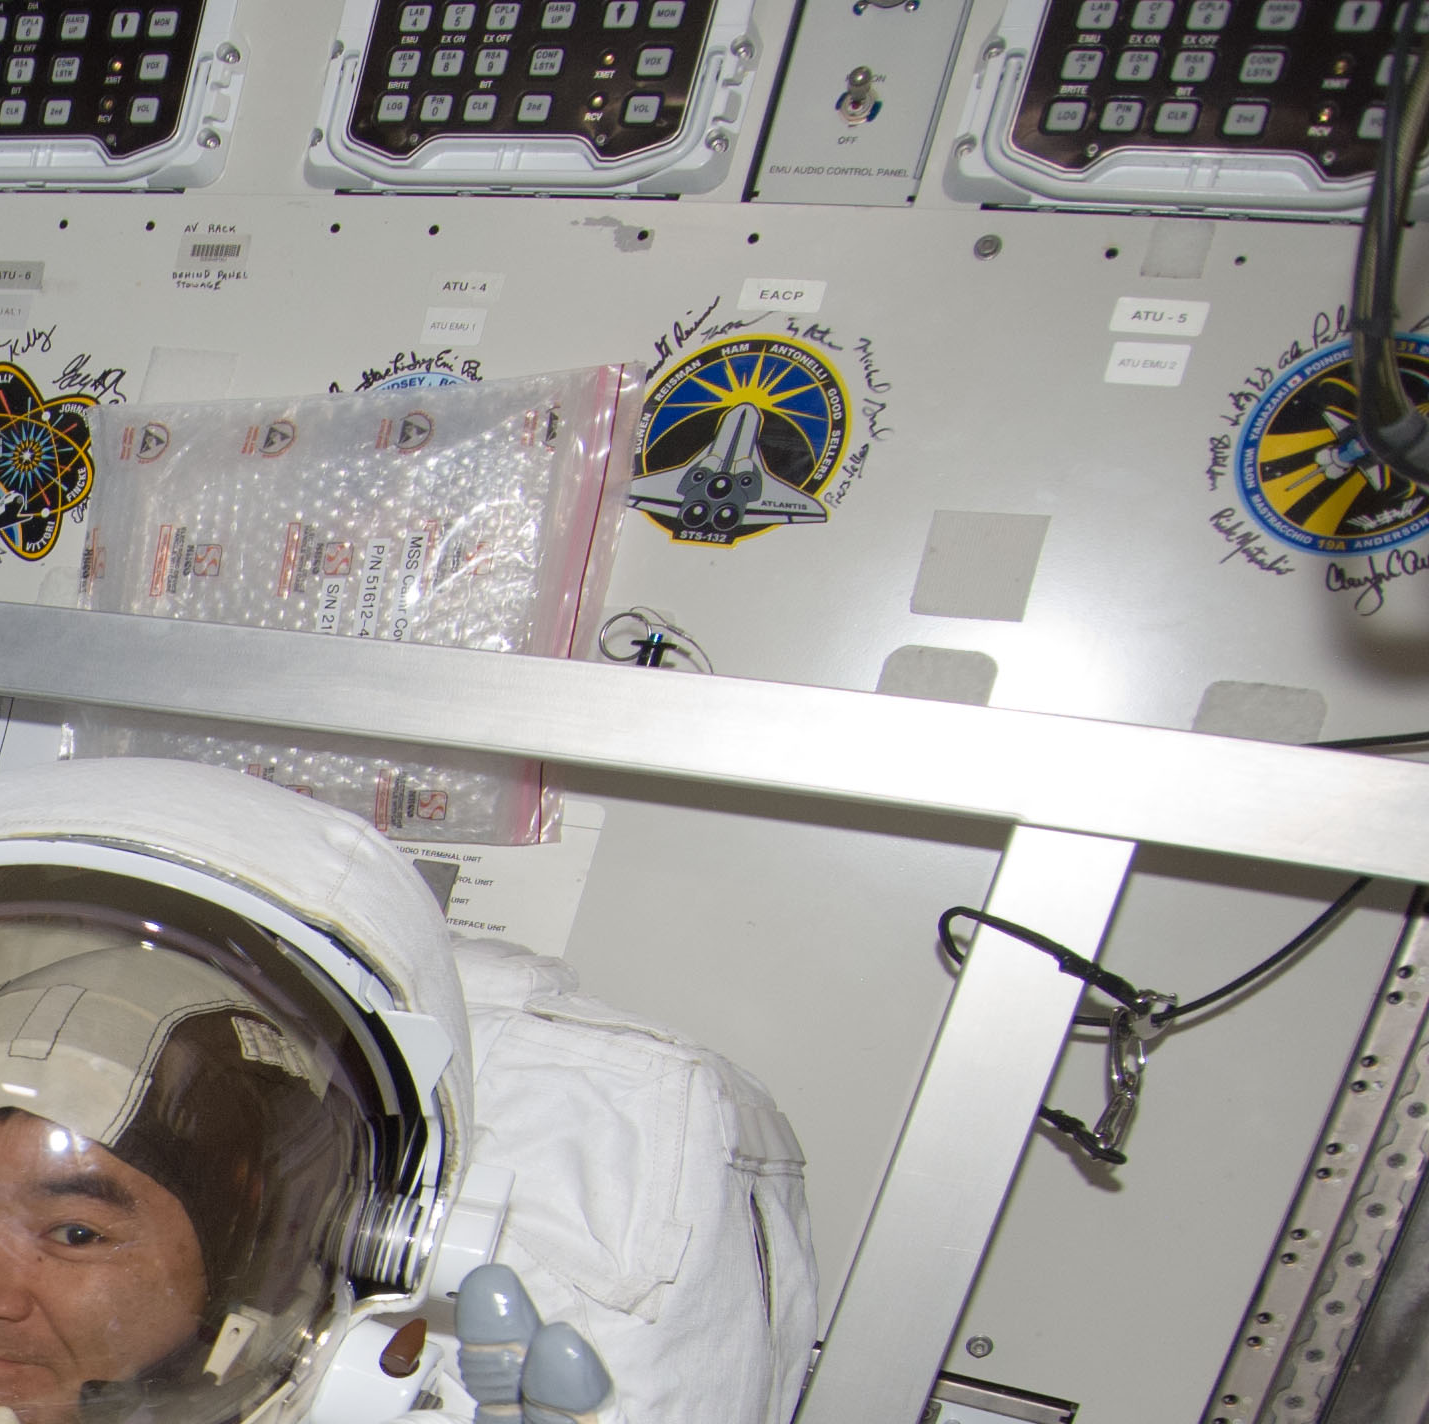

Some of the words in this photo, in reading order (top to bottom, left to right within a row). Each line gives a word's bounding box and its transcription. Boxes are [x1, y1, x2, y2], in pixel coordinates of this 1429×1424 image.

[408, 7, 425, 17] LAB
[455, 6, 466, 15] CF
[494, 5, 516, 15] CPLA
[547, 4, 571, 14] HANG
[1090, 2, 1111, 12] LAB
[656, 9, 677, 18] MON
[411, 17, 418, 27] 4
[454, 16, 461, 26] 5
[498, 15, 506, 26] 6
[550, 15, 563, 24] UP
[401, 35, 419, 44] EMU
[441, 35, 452, 44] EX
[453, 35, 466, 44] ON
[483, 35, 494, 43] EX
[495, 34, 513, 43] OFF
[397, 53, 415, 62] JEM
[441, 52, 457, 61] ESA
[485, 51, 502, 60] RSA
[535, 50, 559, 60] CONF
[644, 56, 663, 66] VOX
[401, 62, 408, 72] 7
[443, 62, 450, 72] 8
[487, 61, 494, 72] 9
[533, 61, 557, 72] LSTN
[594, 70, 615, 79] XMIT
[479, 80, 493, 89] BIT
[430, 96, 445, 106] PIN
[471, 101, 488, 111] CLR
[386, 102, 403, 111] LOG
[431, 106, 439, 117] 0
[526, 102, 542, 112] 2nd
[633, 104, 650, 114] VOL
[584, 112, 603, 121] RCV
[837, 136, 858, 144] OFF
[769, 166, 791, 174] EMU
[793, 166, 823, 175] AUDIO
[826, 167, 874, 176] CONTROL
[876, 168, 909, 177] PANEL
[184, 222, 198, 233] AV
[208, 224, 236, 233] RACK
[24, 271, 32, 280] 6
[173, 271, 210, 279] BEHIND
[218, 271, 248, 279] PANEL
[176, 281, 221, 290] STOWAGE
[443, 282, 468, 291] ATU
[479, 283, 487, 291] 4
[759, 290, 805, 301] EACP
[1131, 310, 1164, 321] ATU
[1177, 313, 1188, 323] 5
[430, 322, 447, 330] ATU
[721, 343, 750, 356] HAM
[769, 344, 828, 380] ANTONELLI
[1118, 359, 1140, 368] ATU
[1141, 360, 1167, 368] EMU
[1169, 361, 1178, 369] 2
[1304, 349, 1353, 376] POINDE
[654, 359, 701, 402] REISMAN
[827, 388, 841, 420] GOOD
[1249, 386, 1289, 441] YAMAZAKI
[635, 413, 650, 454] BOWEN
[814, 430, 841, 480] SELLERS
[1244, 448, 1255, 488] WILSON
[67, 467, 87, 501] FINCKE
[761, 500, 808, 510] ATLANTIS
[1252, 494, 1312, 545] MASTRACCHIO
[26, 521, 55, 551] VITTORI
[679, 531, 727, 543] STS-132
[1354, 516, 1429, 550] ANDERSON
[1318, 539, 1346, 551] 19A
[369, 545, 385, 570] P/N
[406, 536, 423, 570] MSS
[324, 584, 339, 610] S/N
[358, 576, 379, 638] 51612-4
[422, 849, 460, 860] TERMINAL
